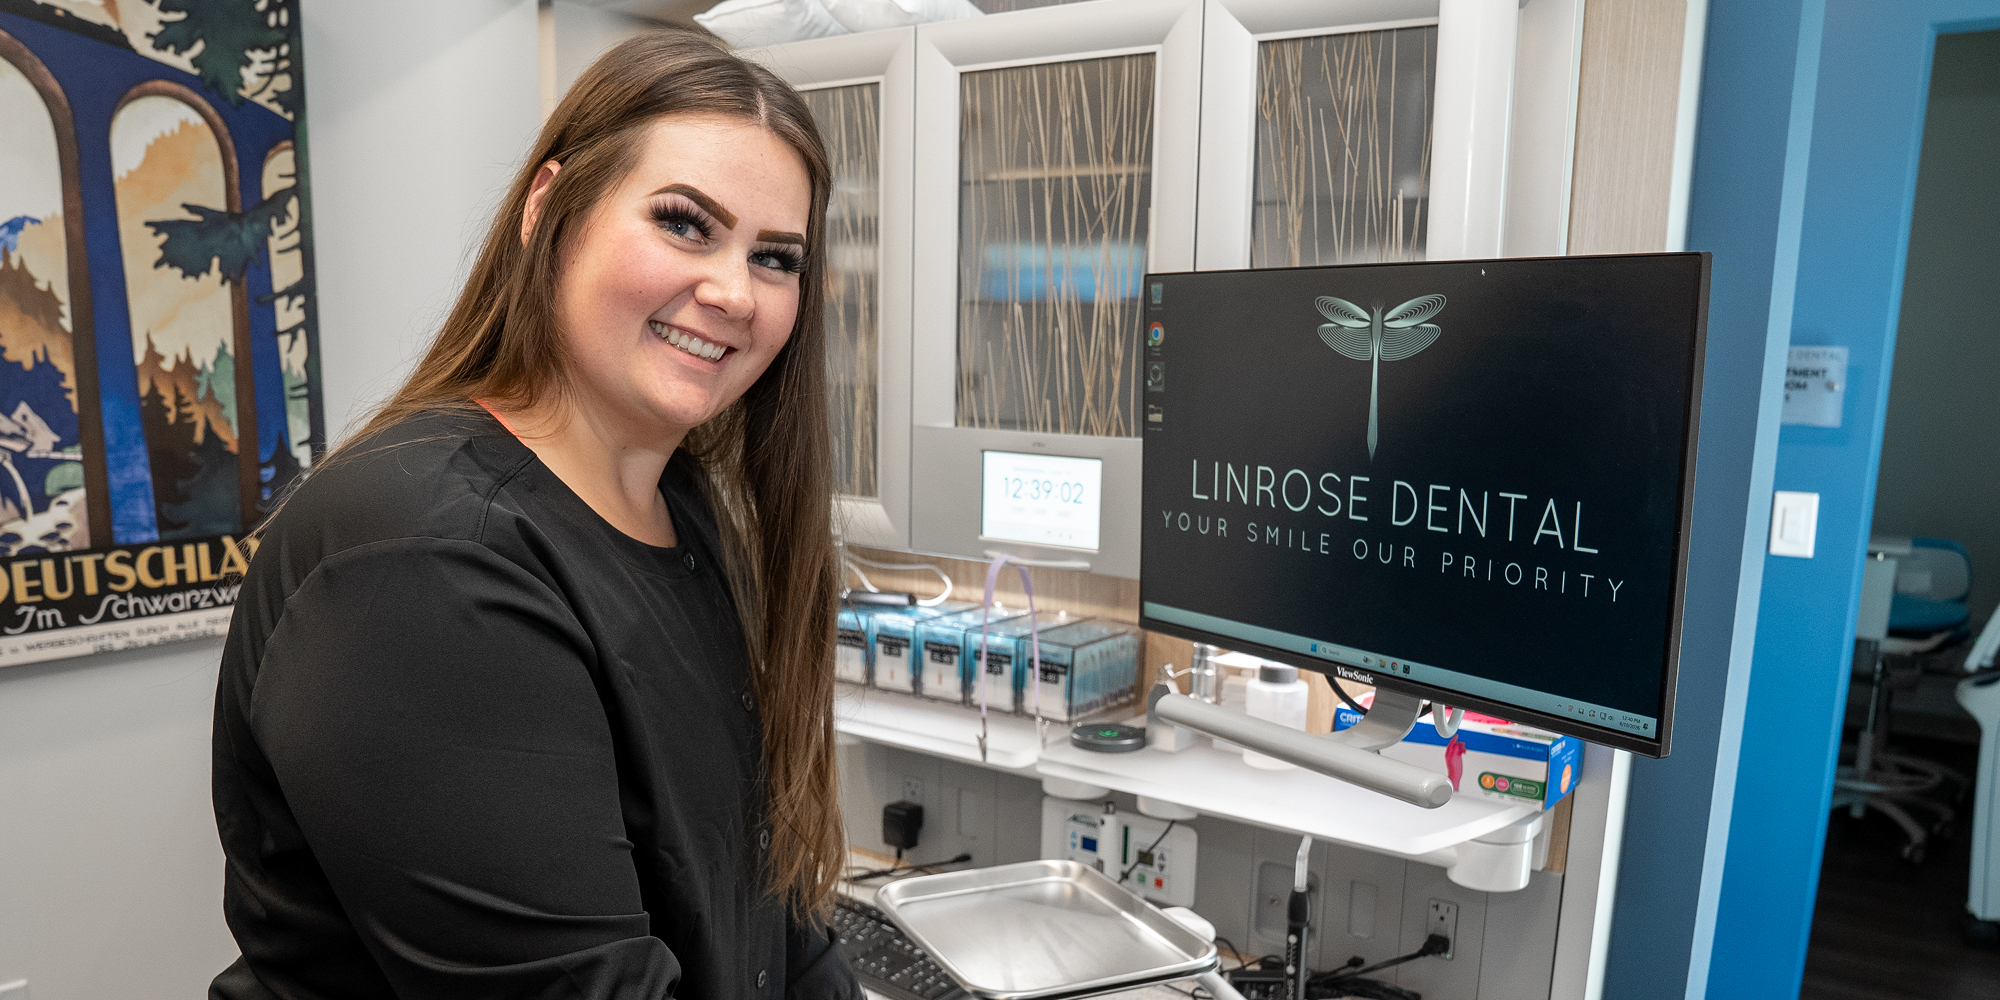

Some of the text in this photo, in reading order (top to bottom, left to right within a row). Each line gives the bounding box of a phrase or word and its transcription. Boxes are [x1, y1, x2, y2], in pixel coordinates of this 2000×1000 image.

[1004, 477, 1084, 504] 12:39:02
[1192, 458, 1599, 555] LINROSE DENTAL
[1162, 510, 1624, 603] YOUR SMILE OUR PRIORITY
[78, 584, 242, 625] Schwarzw
[1336, 666, 1374, 684] ViewSonic
